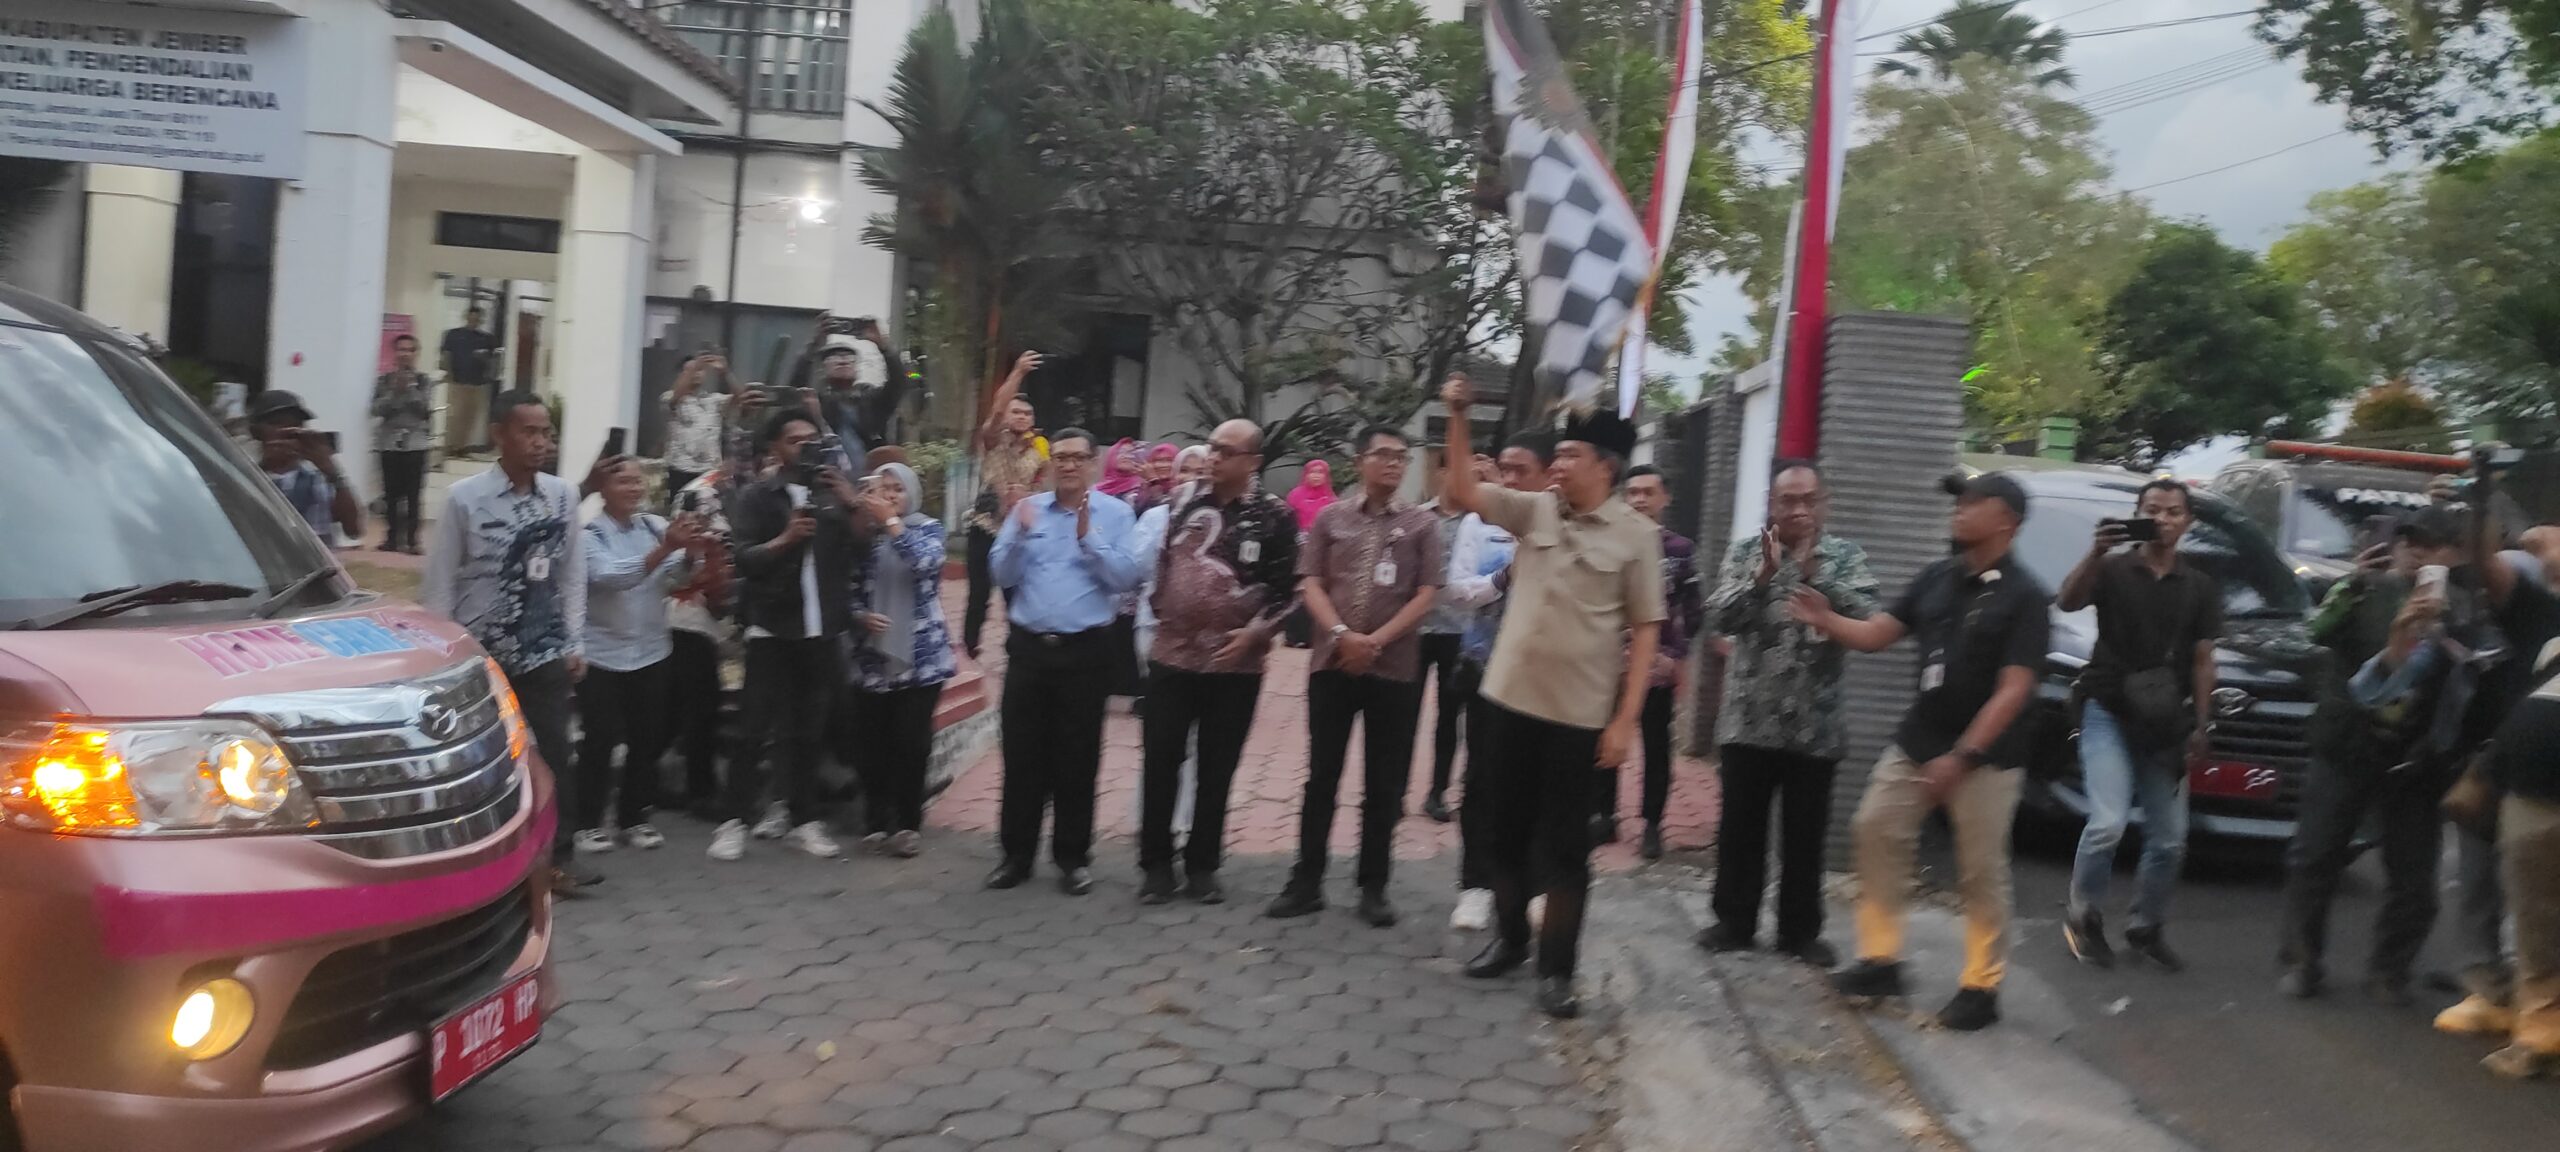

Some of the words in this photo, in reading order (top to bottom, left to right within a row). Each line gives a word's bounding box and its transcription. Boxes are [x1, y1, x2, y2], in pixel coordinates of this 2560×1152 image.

[151, 30, 248, 54] JEMBER
[67, 49, 253, 82] PENGENDALIAN
[133, 82, 280, 110] BERENCANA
[170, 624, 329, 679] HOME
